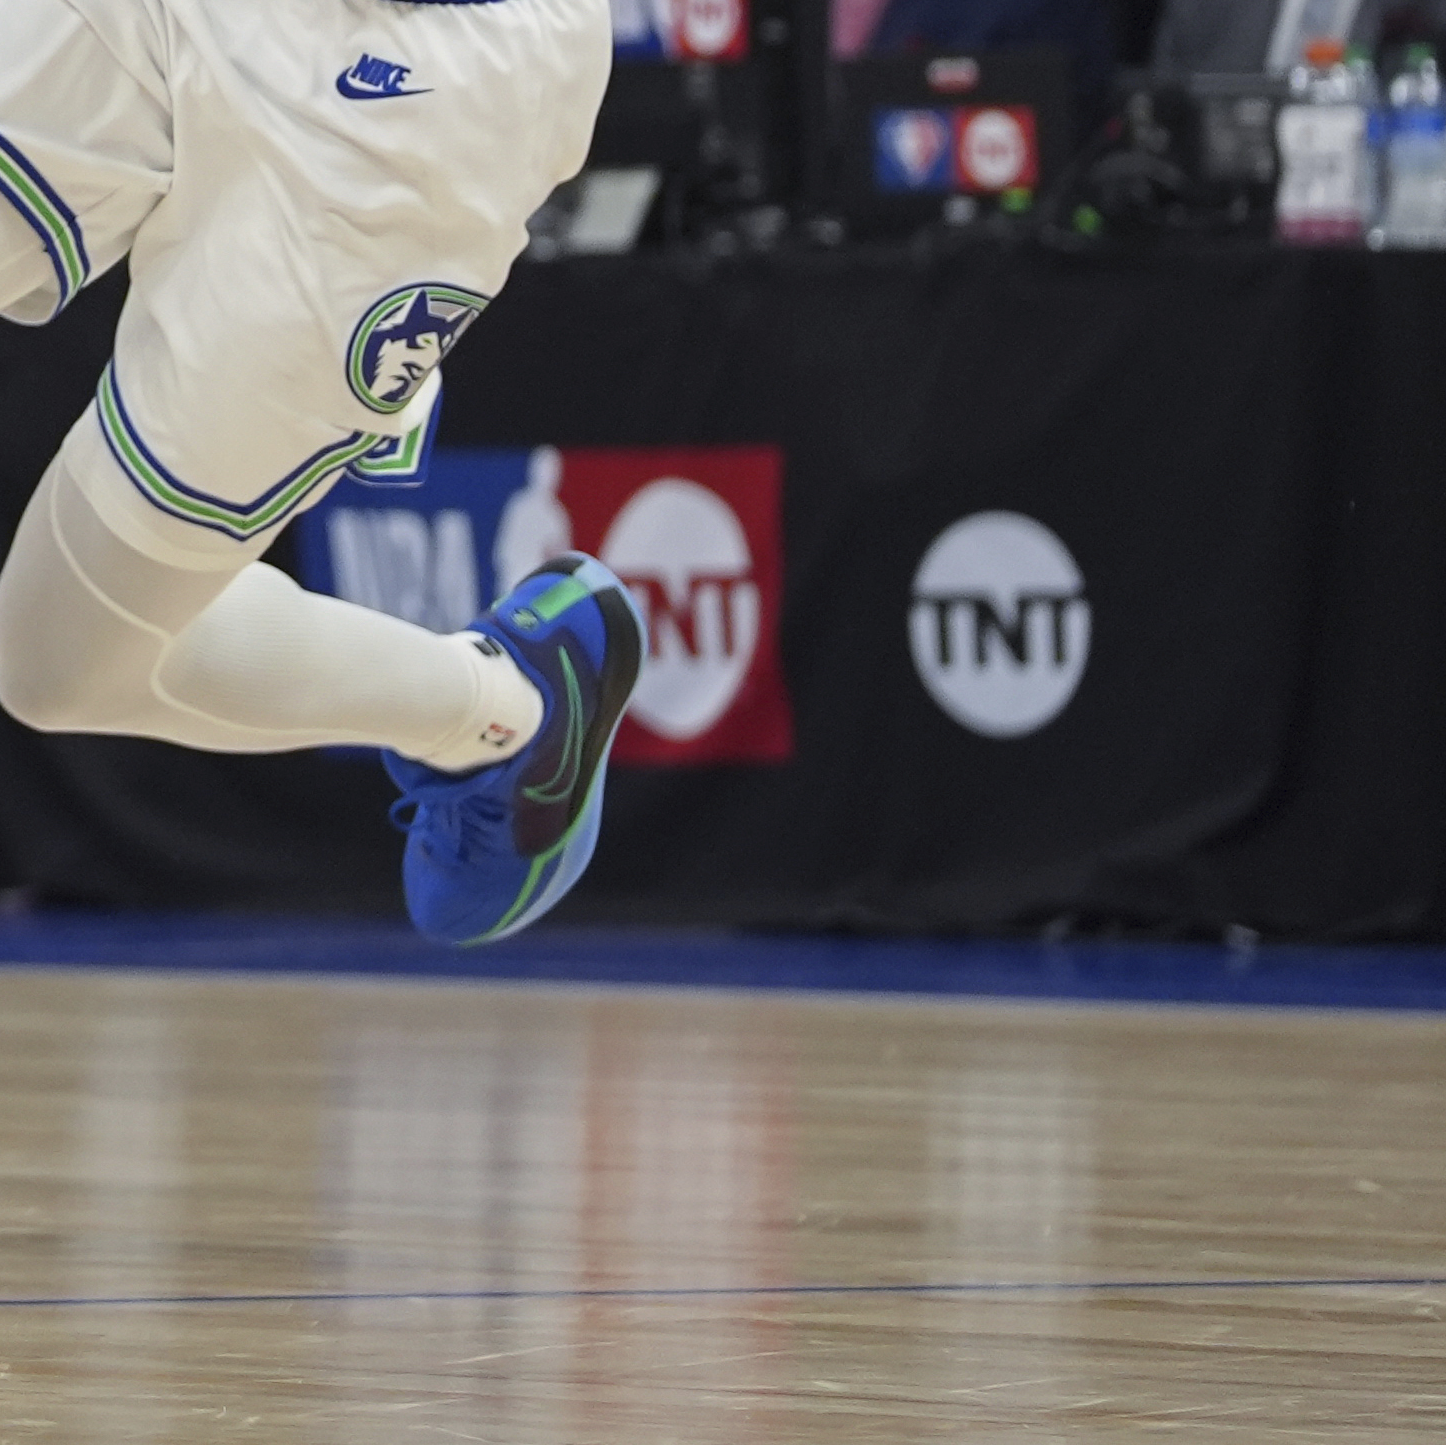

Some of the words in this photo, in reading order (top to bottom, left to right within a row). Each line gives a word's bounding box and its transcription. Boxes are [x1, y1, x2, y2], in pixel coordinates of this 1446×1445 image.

[327, 508, 481, 635] NBA
[624, 575, 751, 660] NT
[911, 594, 1077, 667] TNT
